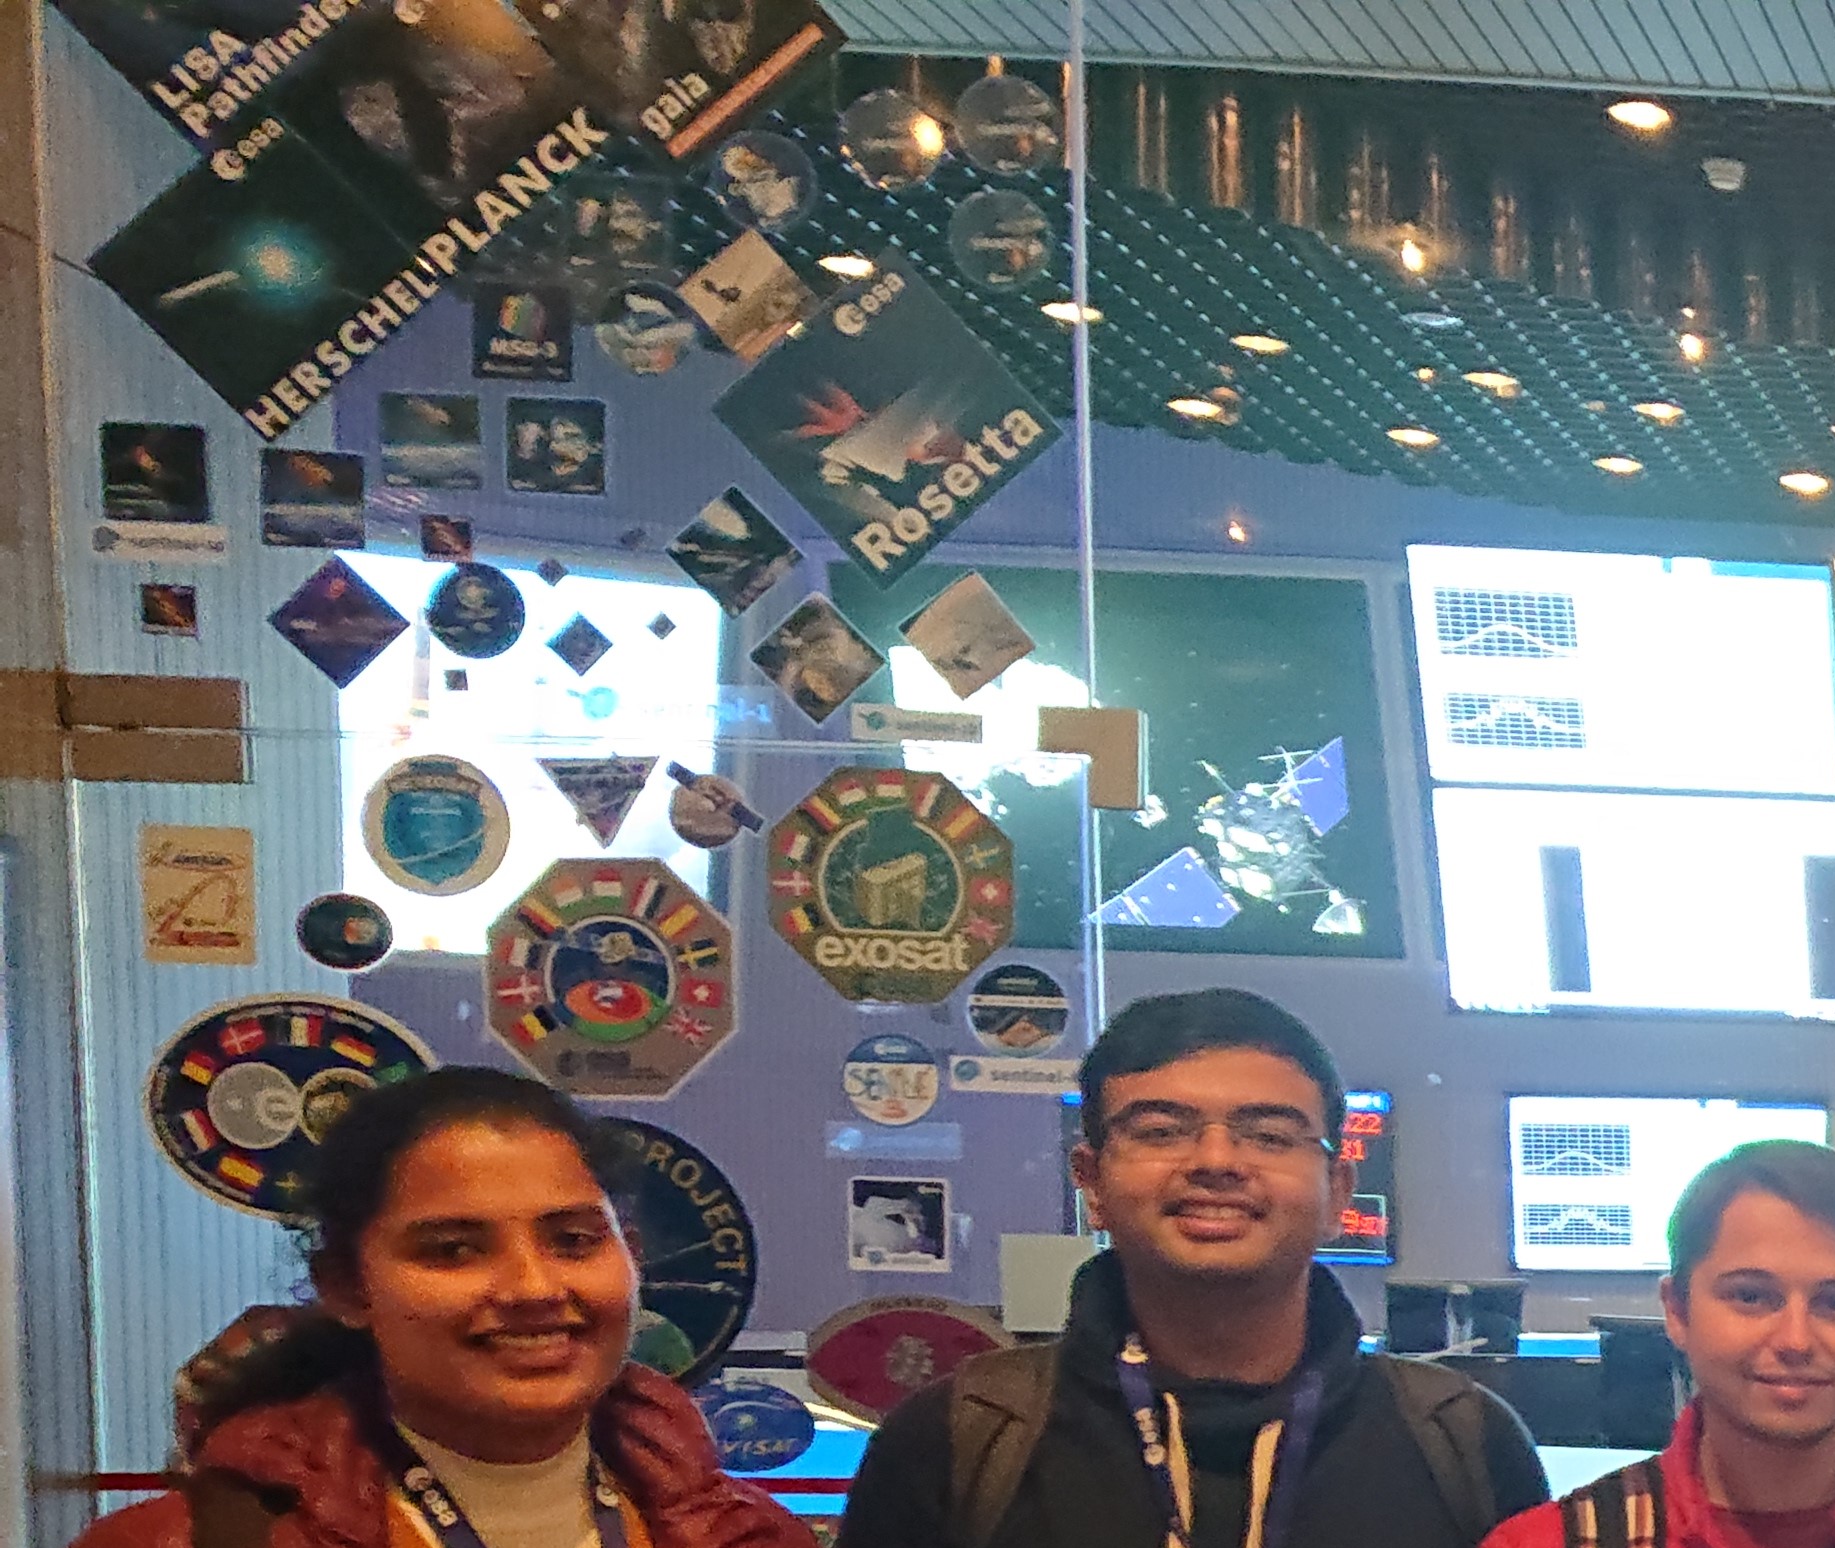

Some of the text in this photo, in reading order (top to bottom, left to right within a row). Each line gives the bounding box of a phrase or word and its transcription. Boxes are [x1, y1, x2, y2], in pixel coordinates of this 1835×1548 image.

[151, 29, 247, 110] LISA
[179, 0, 361, 139] Pathfinde
[640, 73, 711, 140] gaia
[244, 106, 610, 440] HERSCHEL PLANCK
[851, 407, 1044, 572] Rosetta
[815, 934, 970, 971] exosat
